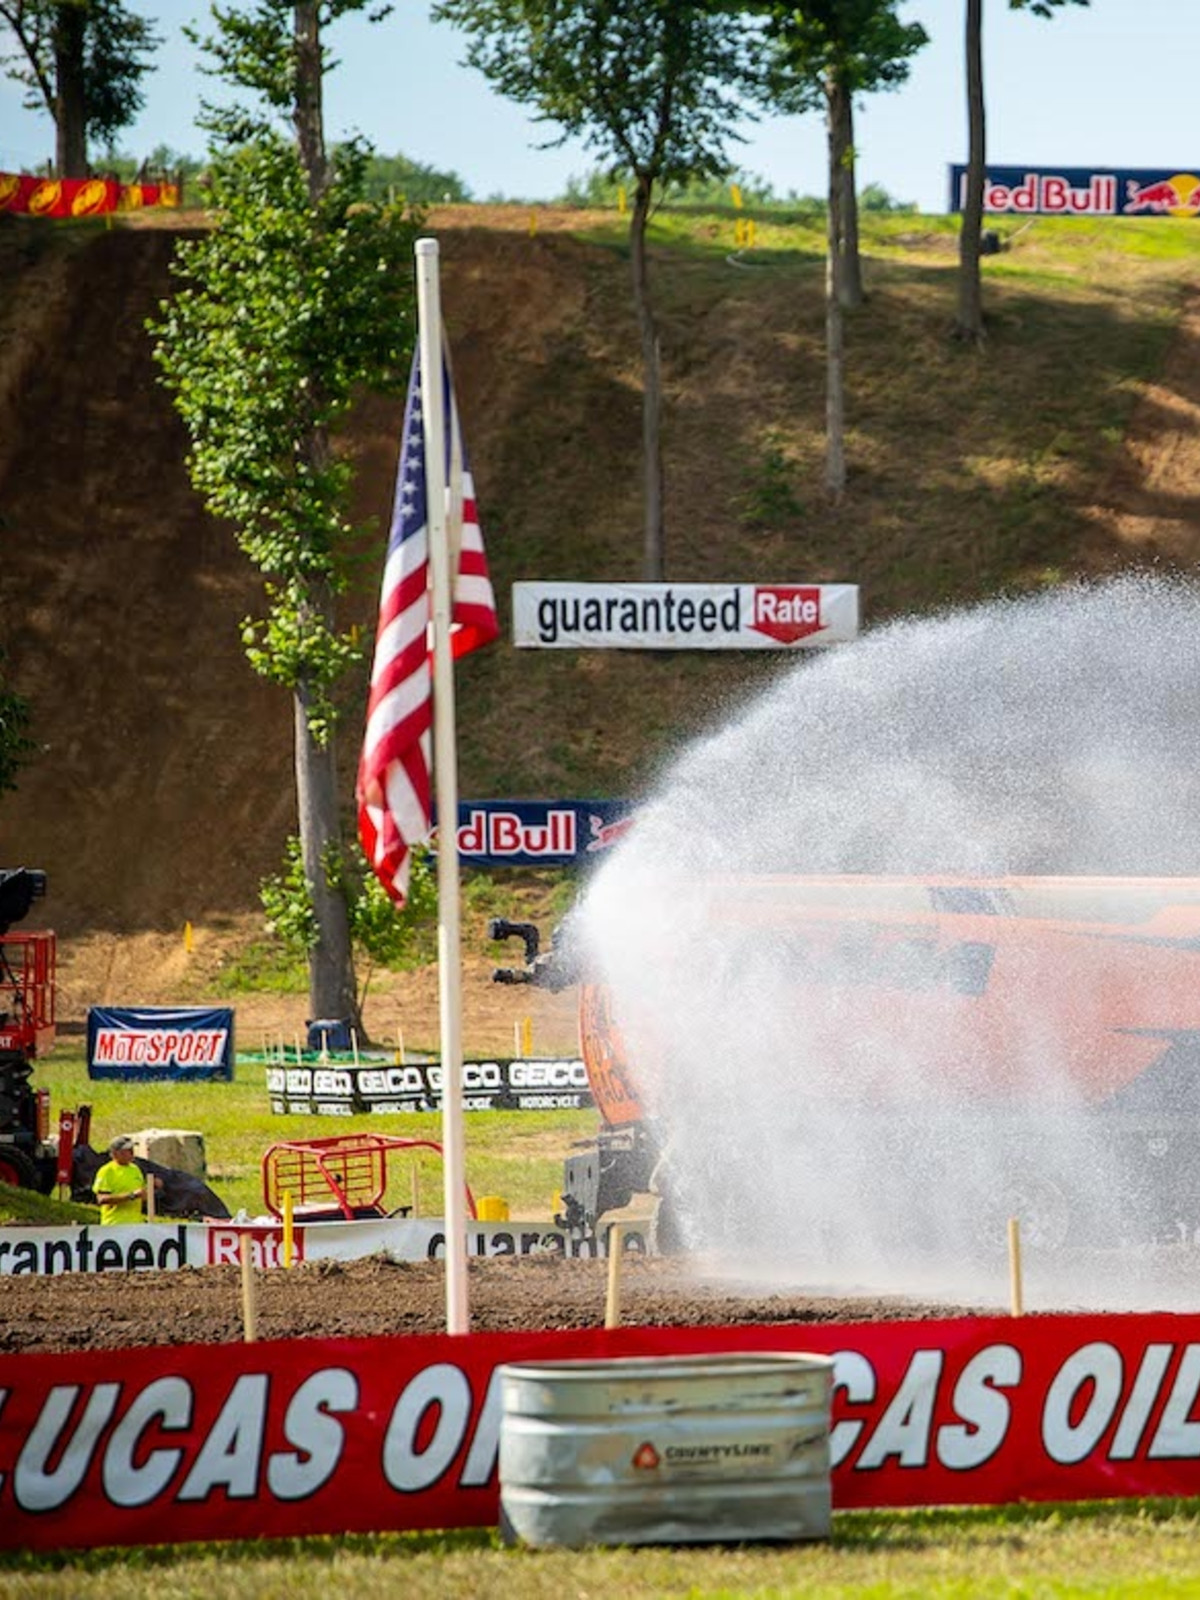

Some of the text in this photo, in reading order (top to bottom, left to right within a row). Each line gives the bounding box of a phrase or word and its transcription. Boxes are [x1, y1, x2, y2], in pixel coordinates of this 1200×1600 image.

[961, 174, 1117, 214] ed Bull
[538, 586, 819, 643] guaranteed Rate
[489, 810, 576, 855] Bull
[358, 1067, 423, 1094] GEICO
[426, 1063, 500, 1091] GCO
[508, 1061, 589, 1087] GEICO
[830, 1342, 1024, 1470] CAS
[0, 1366, 362, 1513] UCAS
